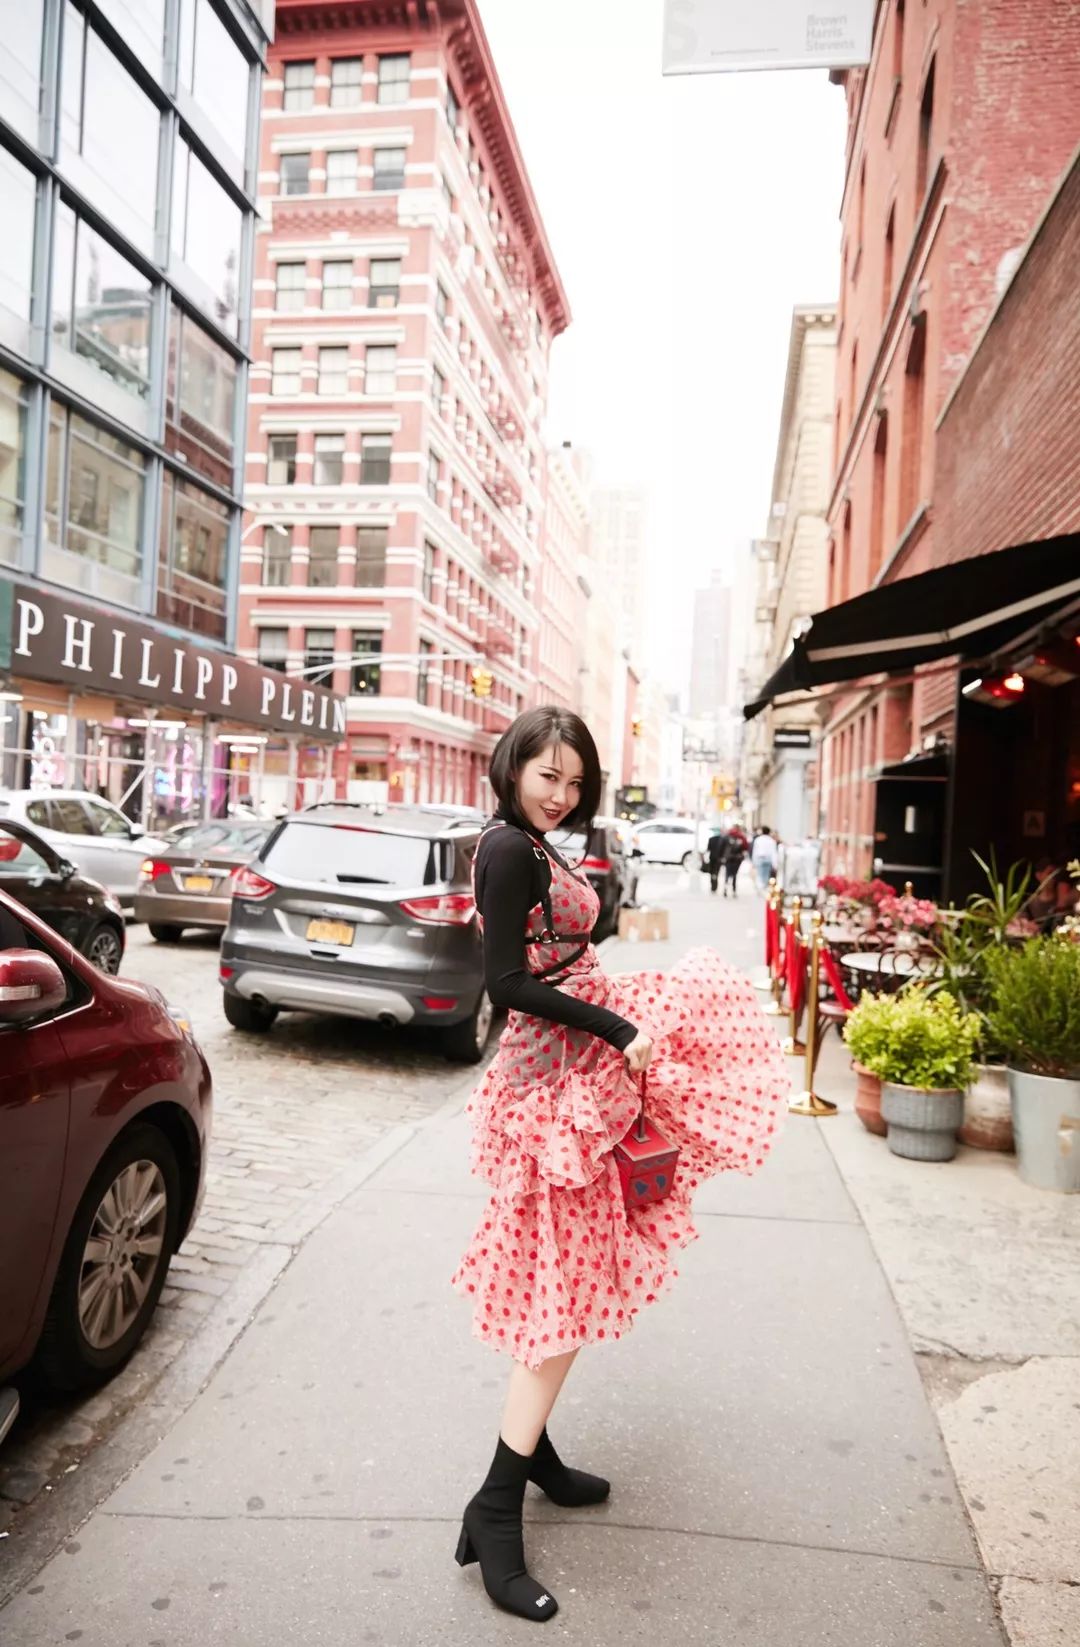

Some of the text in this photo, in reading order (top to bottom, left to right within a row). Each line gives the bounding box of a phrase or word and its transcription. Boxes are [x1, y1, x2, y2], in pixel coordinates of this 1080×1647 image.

[806, 13, 848, 26] Brown
[806, 26, 843, 39] Harris
[805, 39, 855, 52] Stevens
[15, 598, 346, 734] PHILIPP PLEIN
